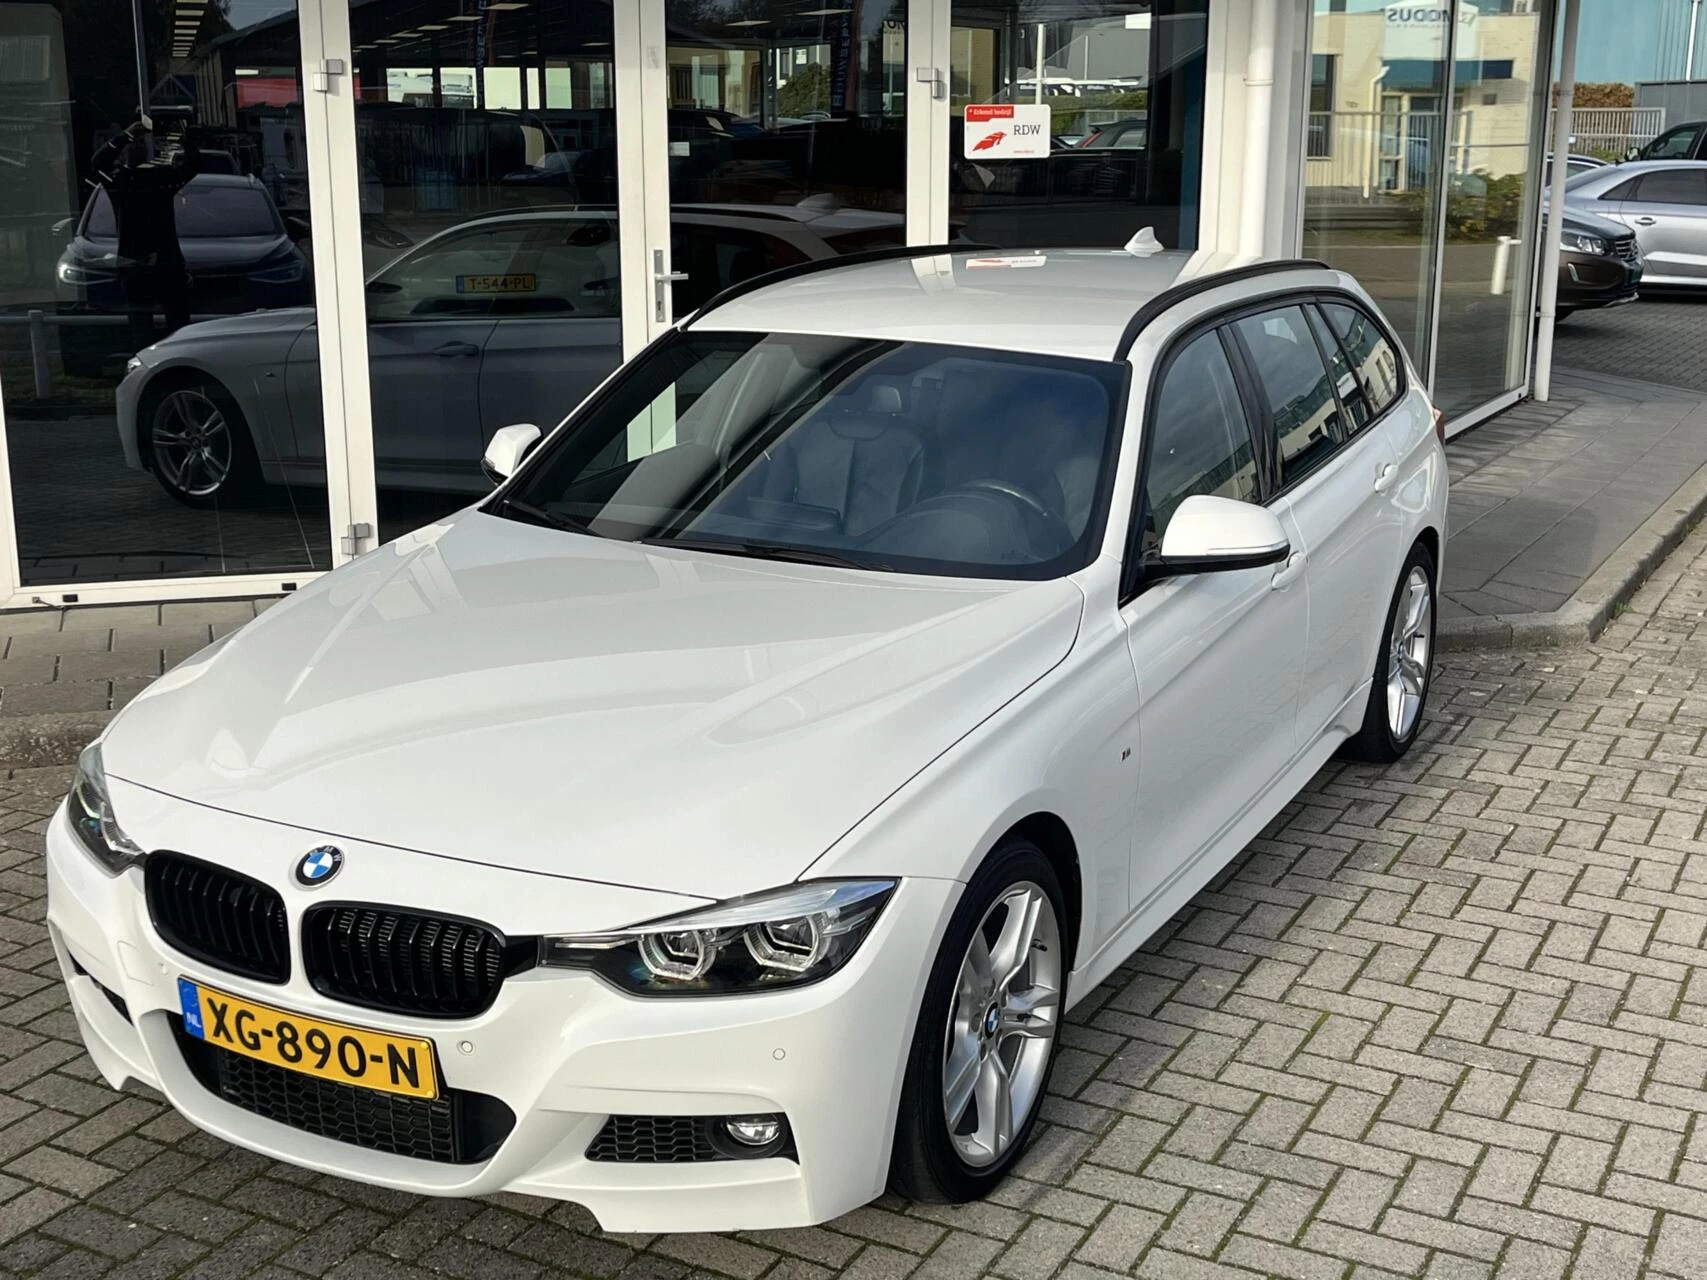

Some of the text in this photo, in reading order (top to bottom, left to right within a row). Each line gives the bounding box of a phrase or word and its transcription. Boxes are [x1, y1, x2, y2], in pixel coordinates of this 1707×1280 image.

[1013, 124, 1041, 135] RDW
[469, 277, 530, 290] T-544-PL
[186, 1012, 202, 1028] NL
[206, 997, 420, 1089] XG-890-N
